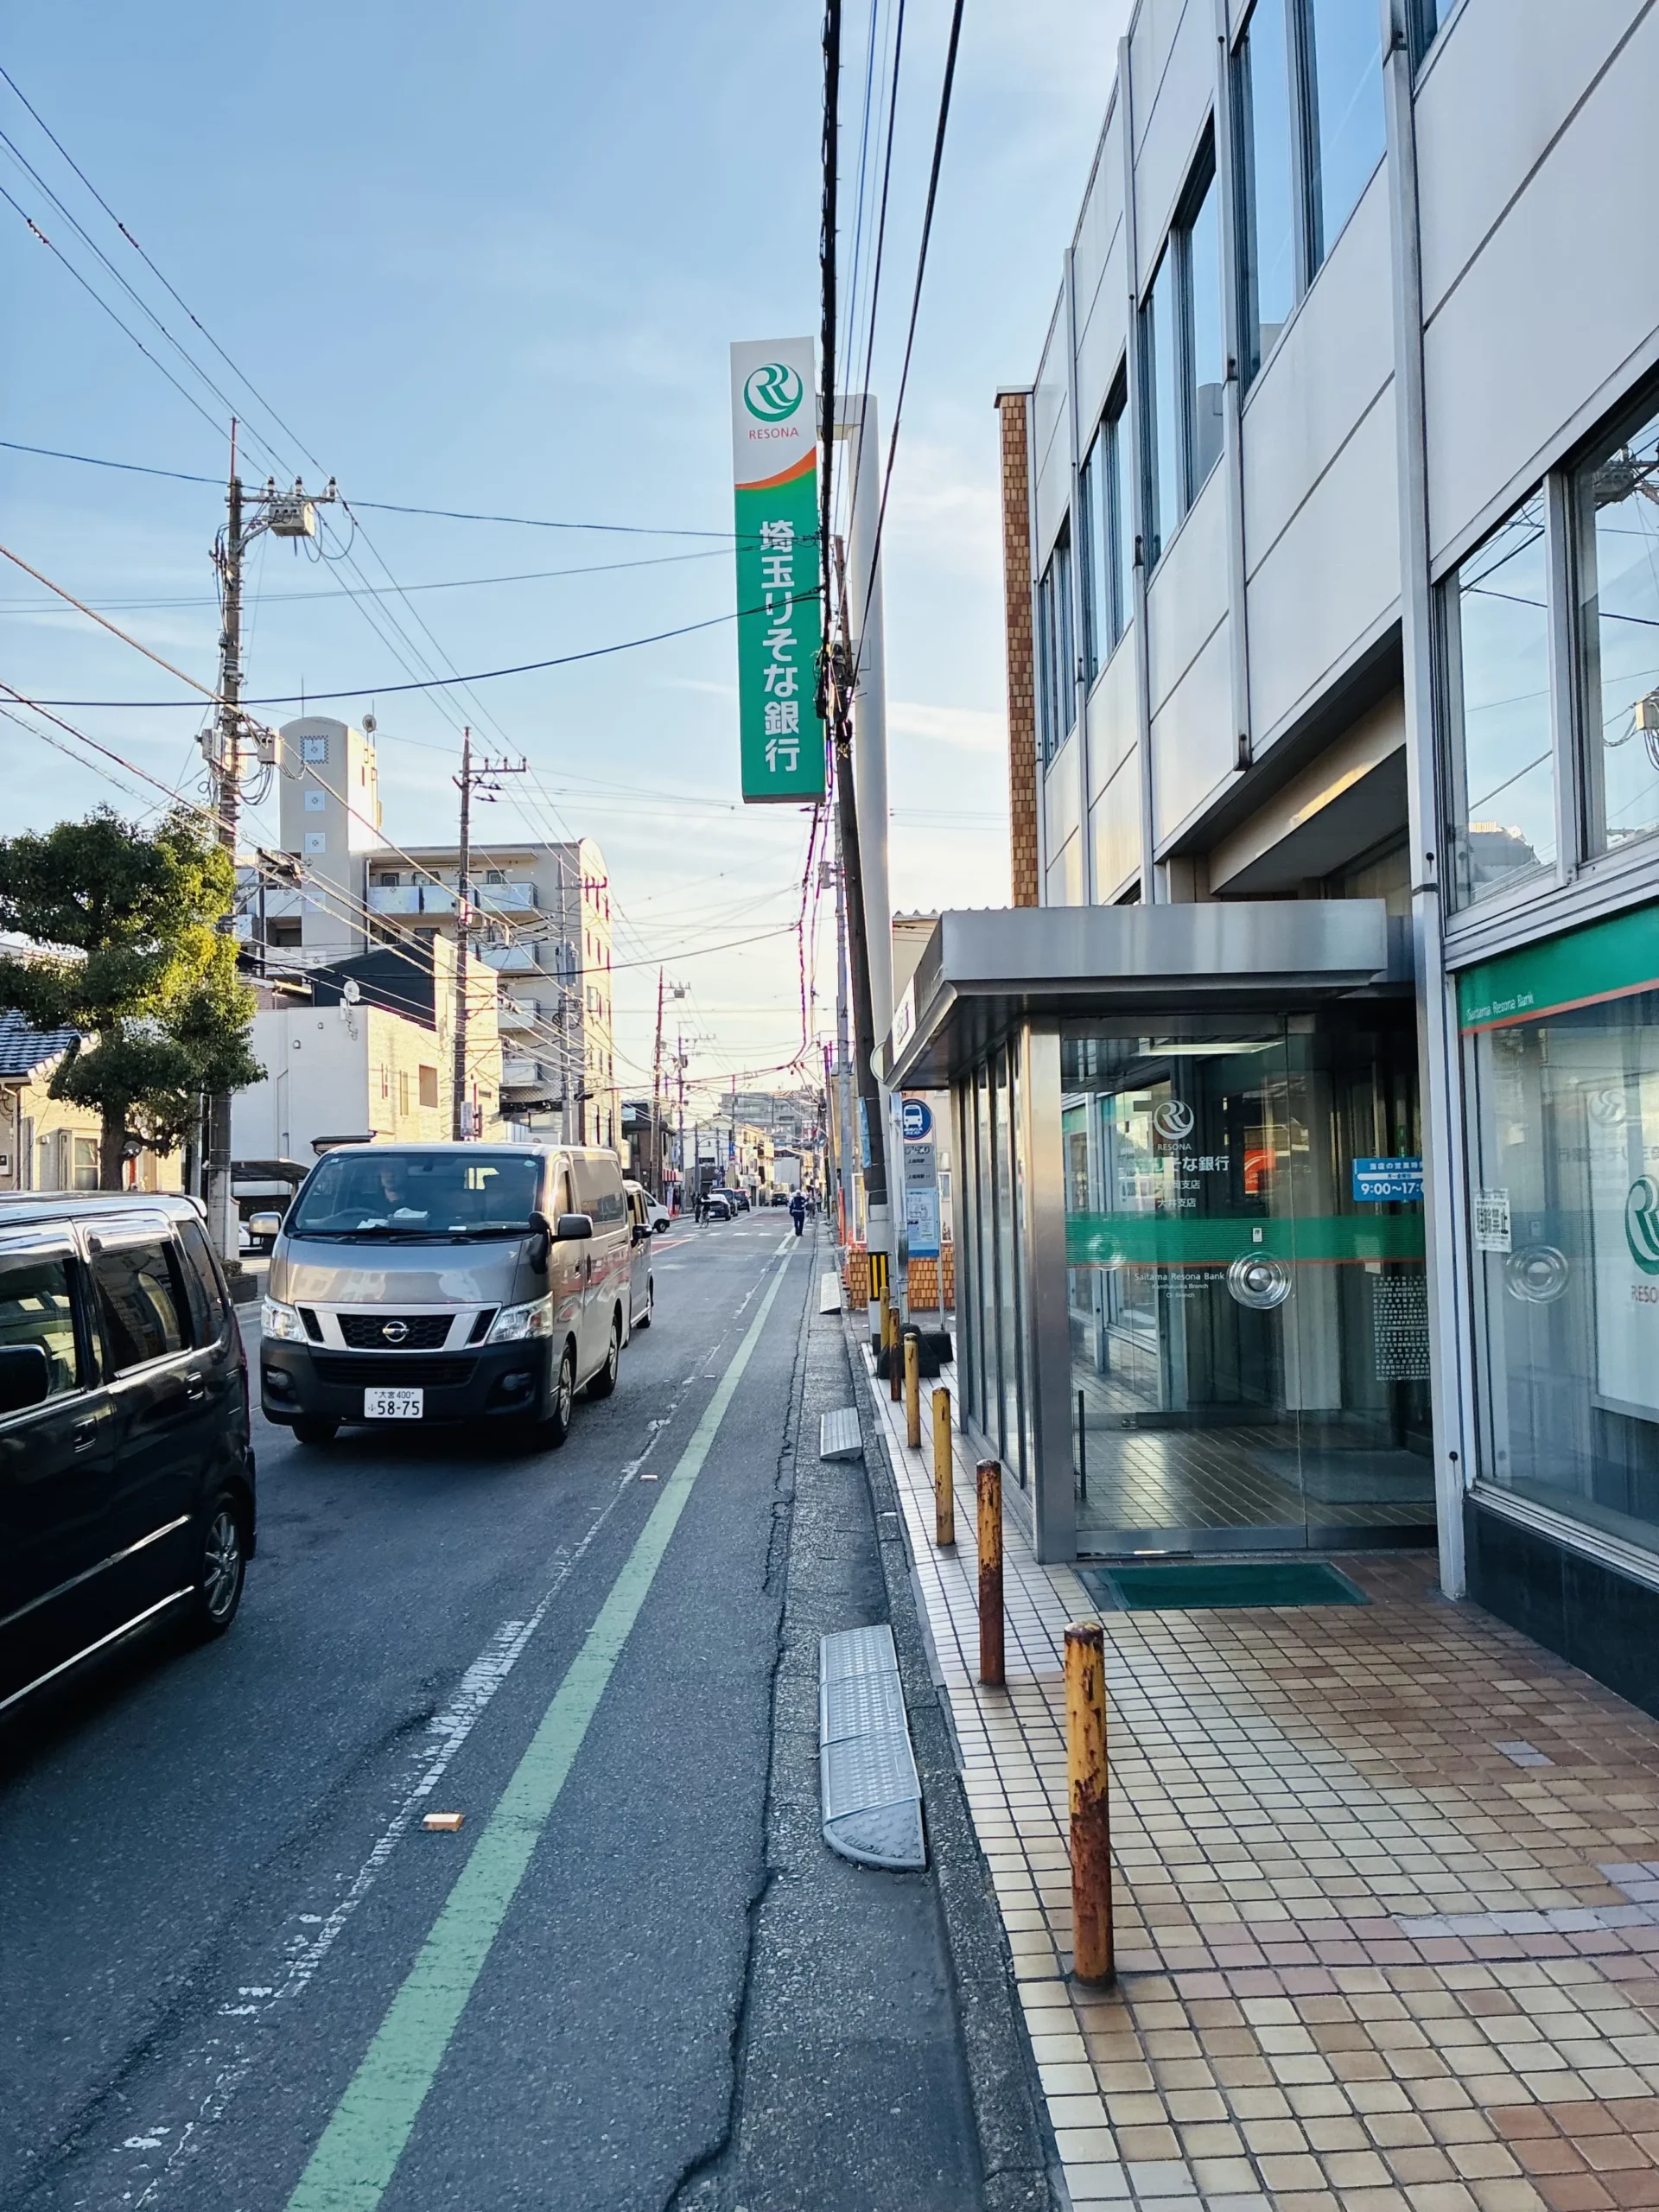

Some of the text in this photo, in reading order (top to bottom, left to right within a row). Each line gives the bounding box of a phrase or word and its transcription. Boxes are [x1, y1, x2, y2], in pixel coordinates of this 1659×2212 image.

[749, 427, 799, 439] RESONA
[759, 518, 800, 772] 埼玉りそな銀行
[1466, 991, 1534, 1021] Saitama Resona Bank
[1134, 1272, 1225, 1281] Saitama Resona Bank
[378, 1400, 420, 1415] 58-75
